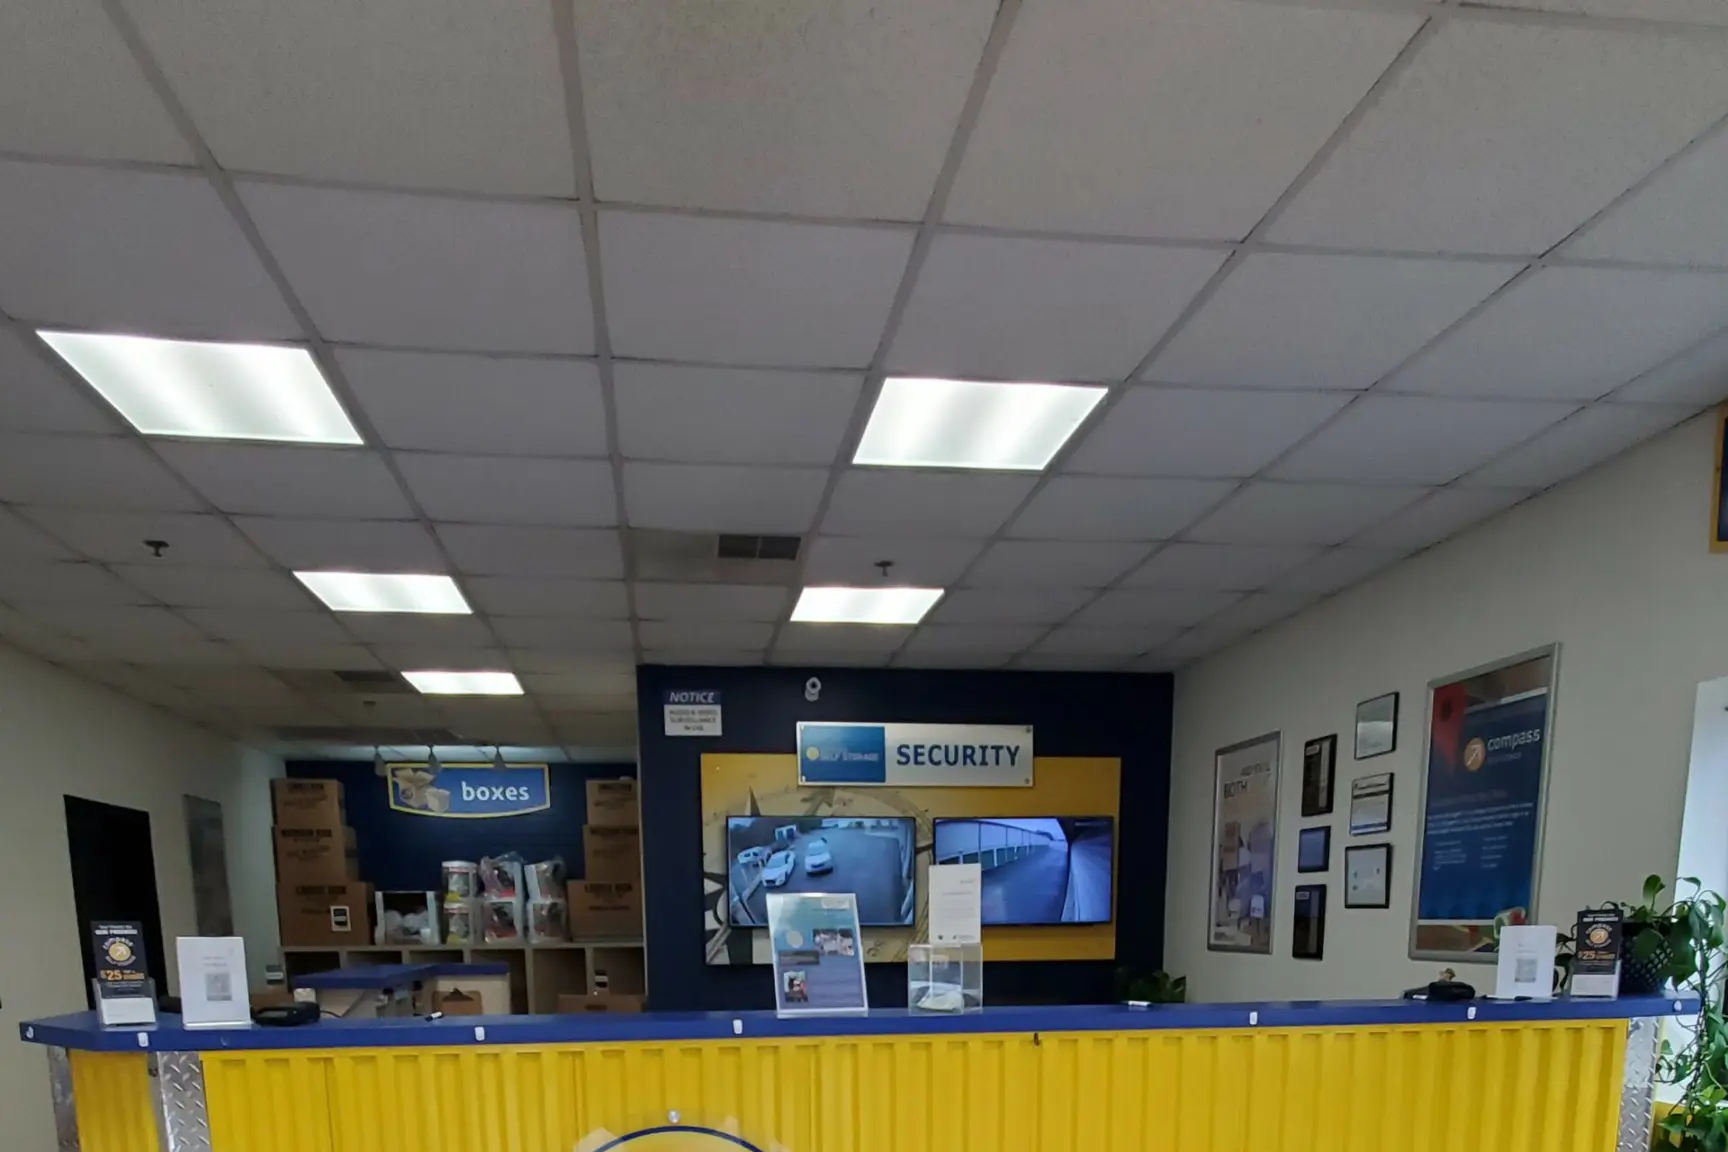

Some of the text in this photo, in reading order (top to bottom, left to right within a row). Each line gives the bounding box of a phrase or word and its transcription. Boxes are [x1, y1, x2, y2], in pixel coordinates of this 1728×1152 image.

[669, 691, 715, 703] NOTICE
[1487, 727, 1541, 752] compass
[896, 744, 1020, 767] SECURITY
[461, 780, 530, 802] boxes
